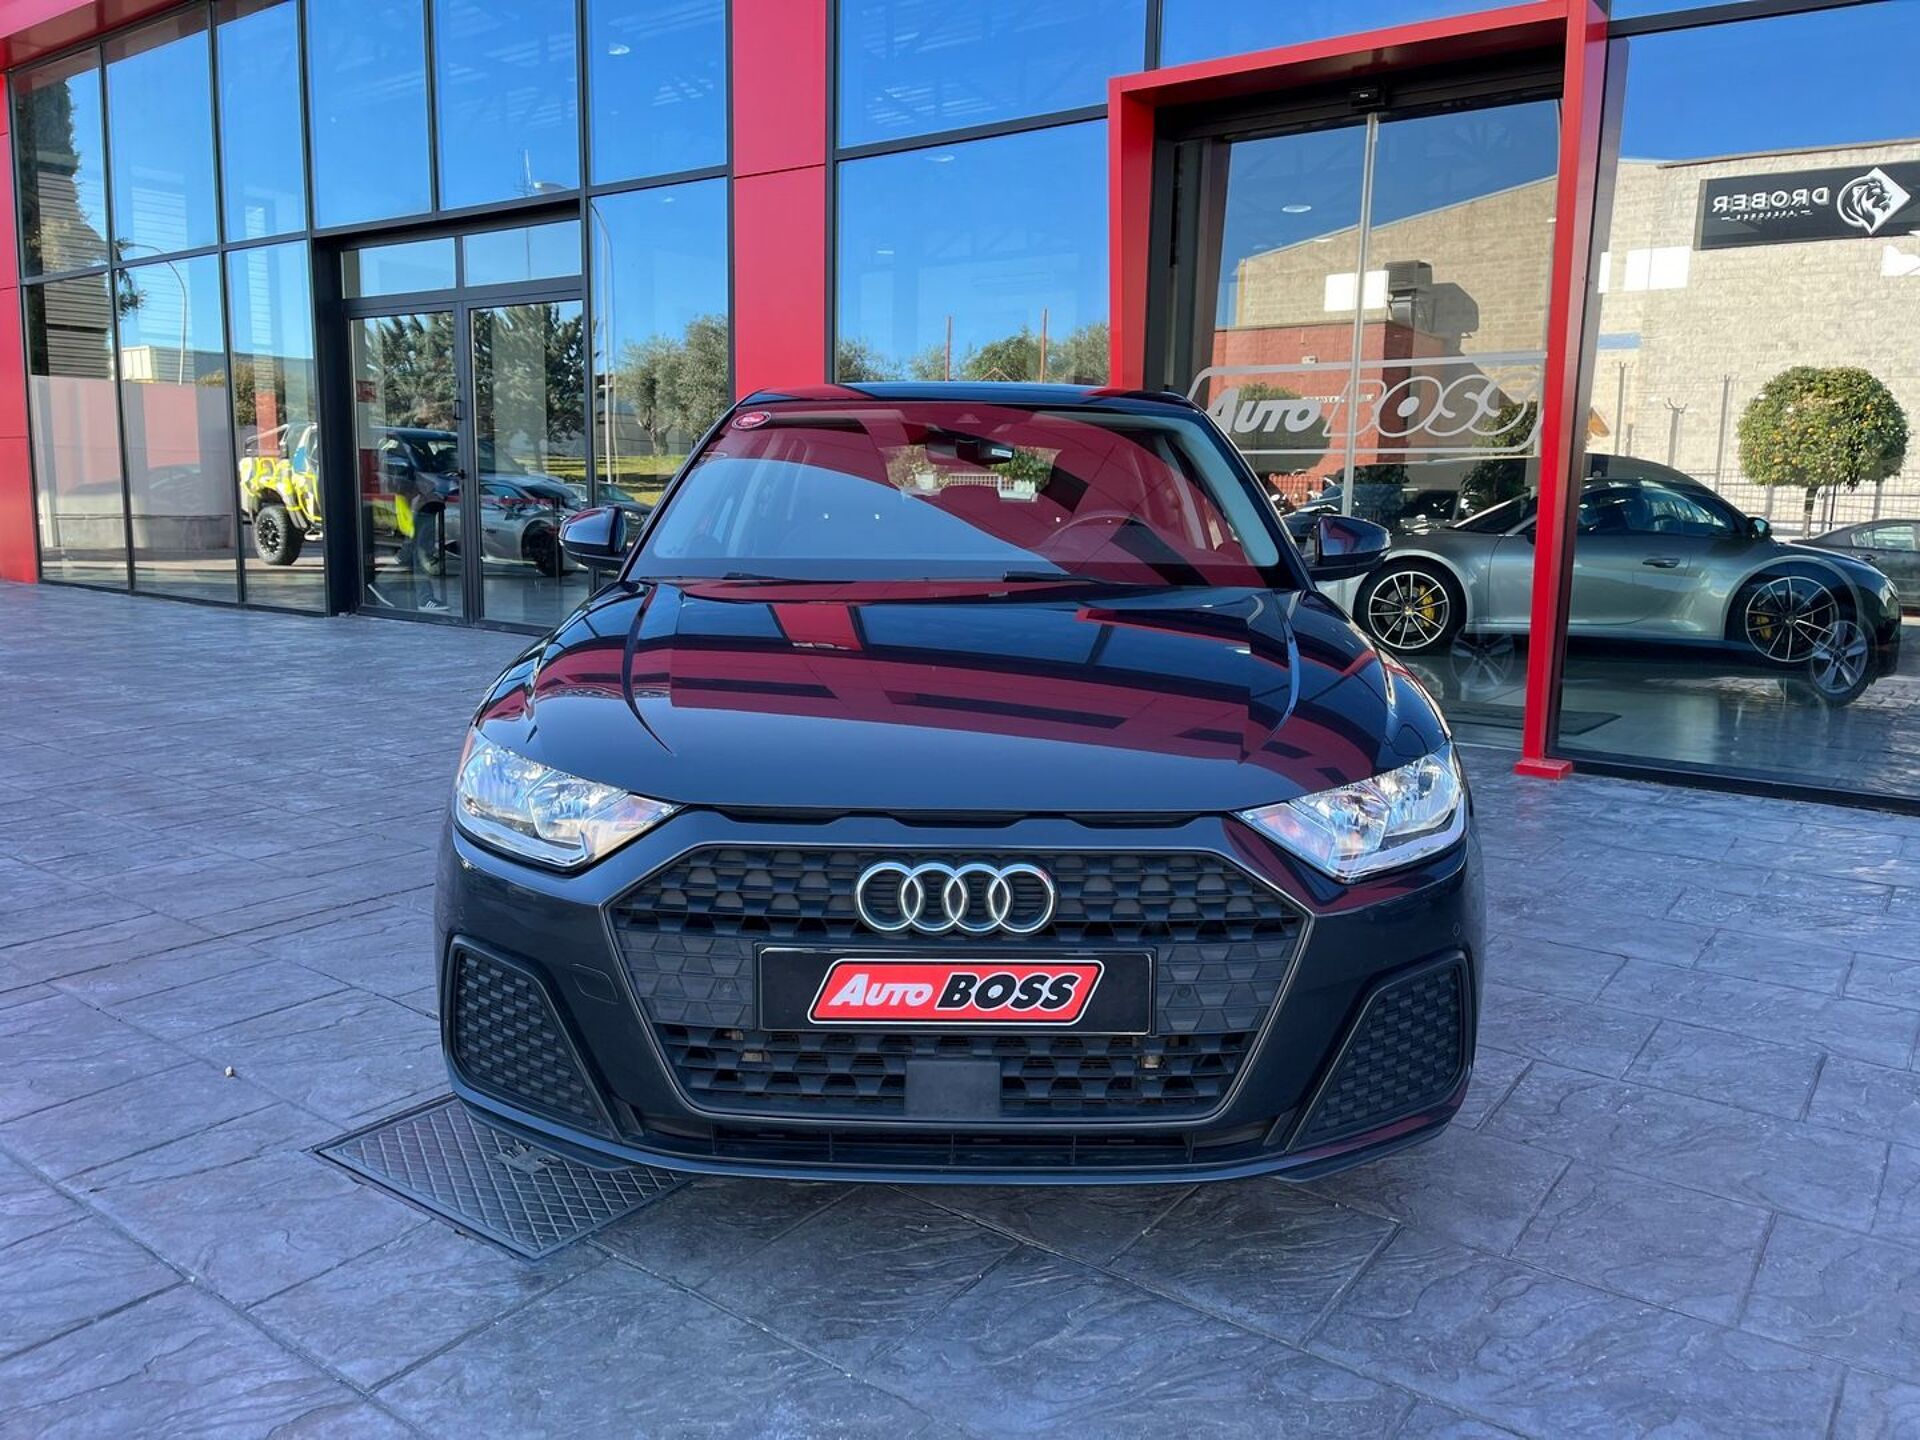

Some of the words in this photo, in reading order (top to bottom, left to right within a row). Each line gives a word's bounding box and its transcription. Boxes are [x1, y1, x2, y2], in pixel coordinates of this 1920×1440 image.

[1206, 387, 1321, 433] AUTO
[1322, 373, 1540, 437] BOSS
[828, 973, 933, 1005] AUTO
[934, 972, 1082, 1011] BOSS
